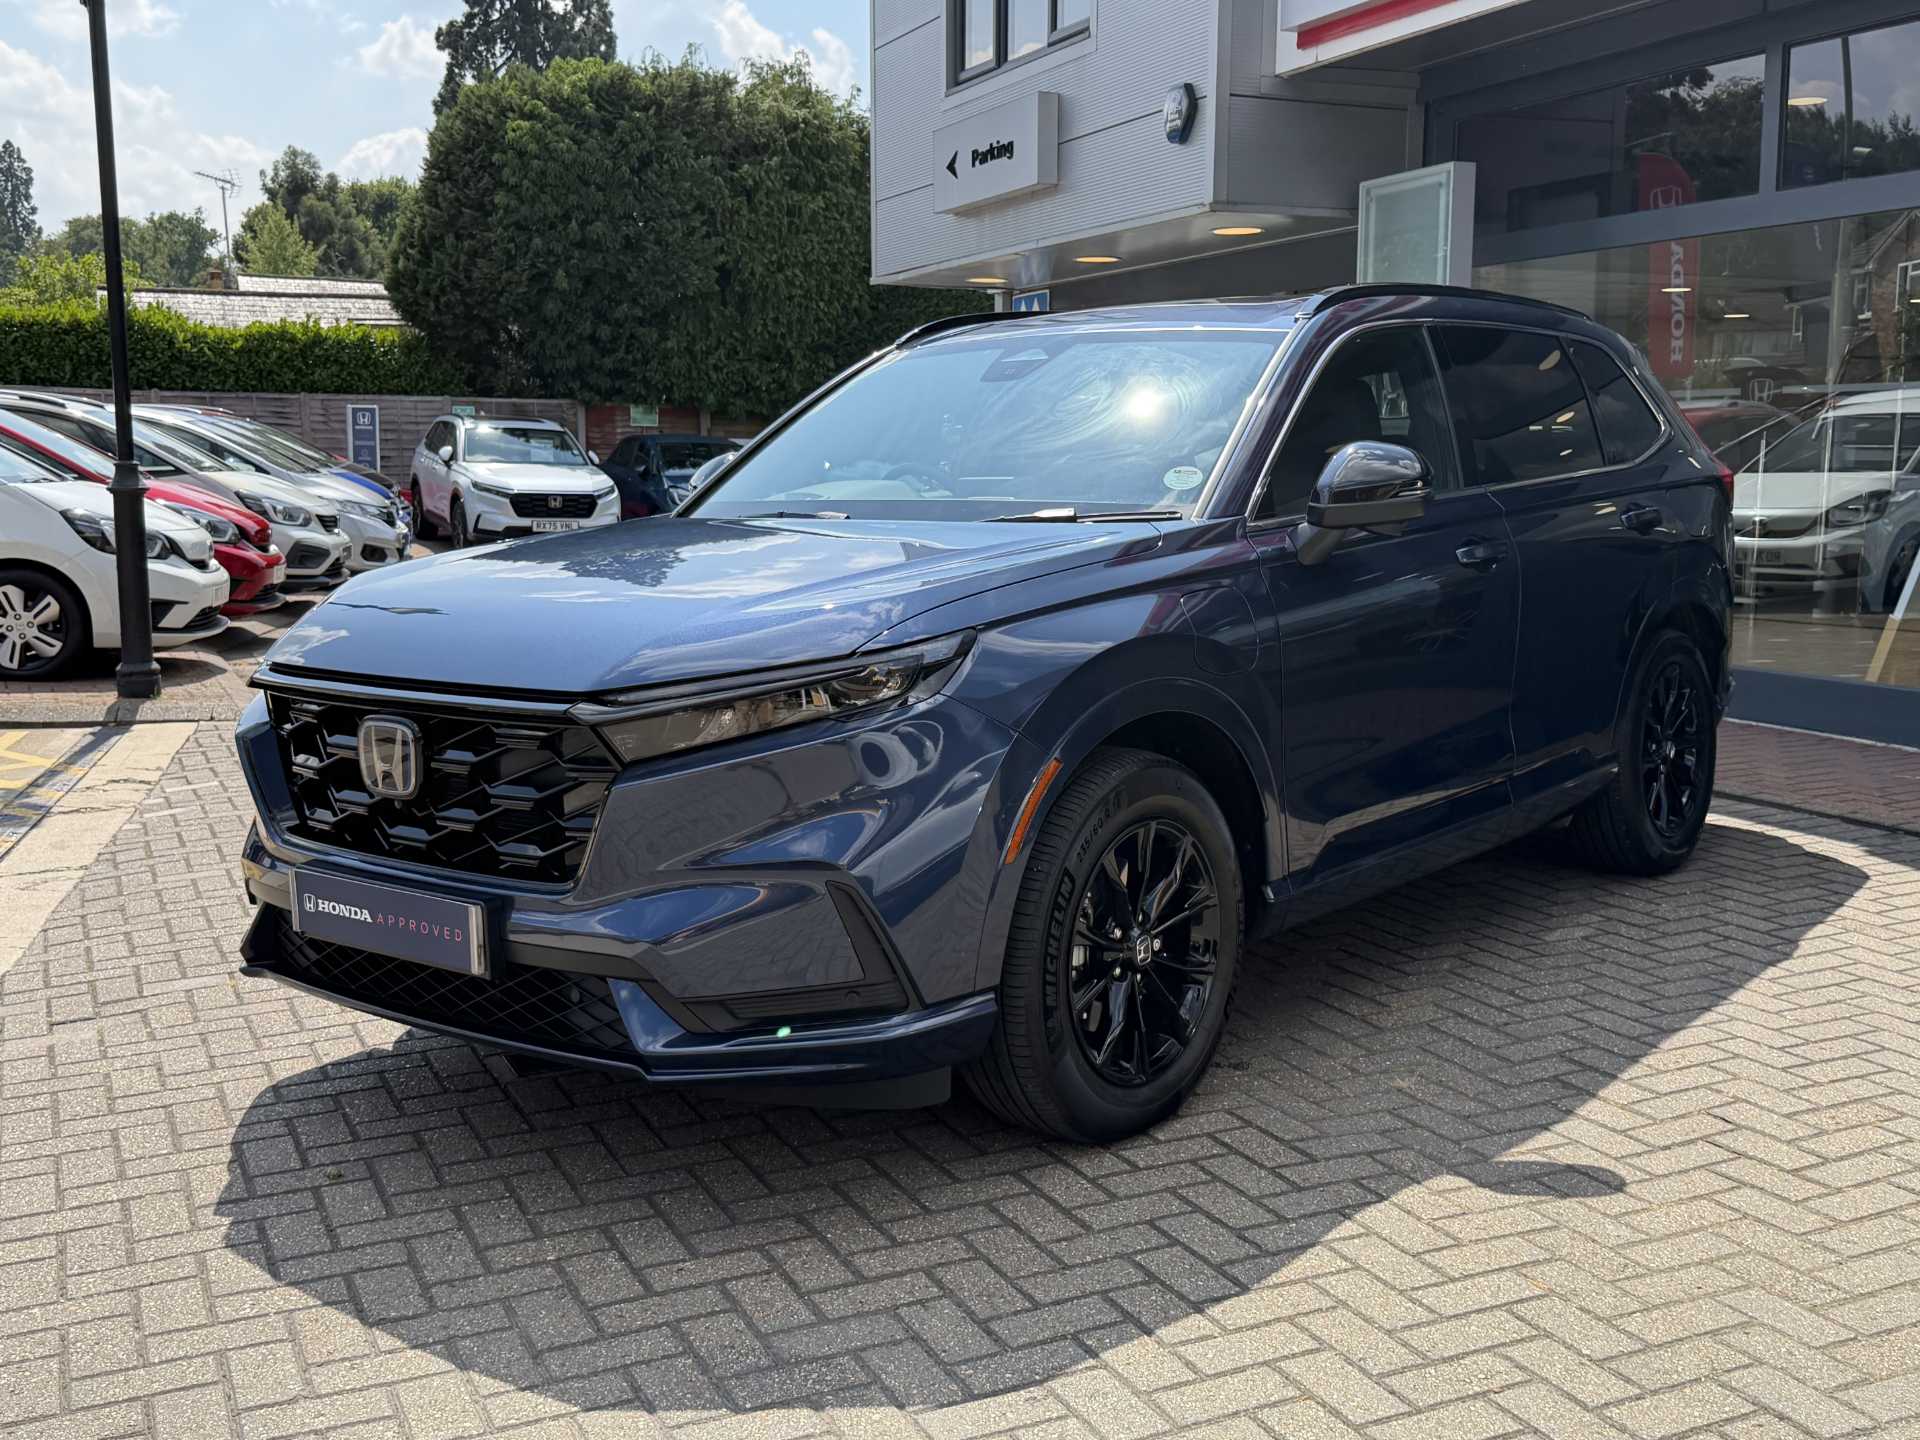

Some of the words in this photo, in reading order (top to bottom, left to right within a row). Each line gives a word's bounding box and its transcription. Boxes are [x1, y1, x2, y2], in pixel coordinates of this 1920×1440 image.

[971, 140, 1014, 168] Parking
[317, 899, 373, 923] HONDA
[376, 913, 463, 942] APPROVED
[1045, 867, 1076, 1006] MICHELIN
